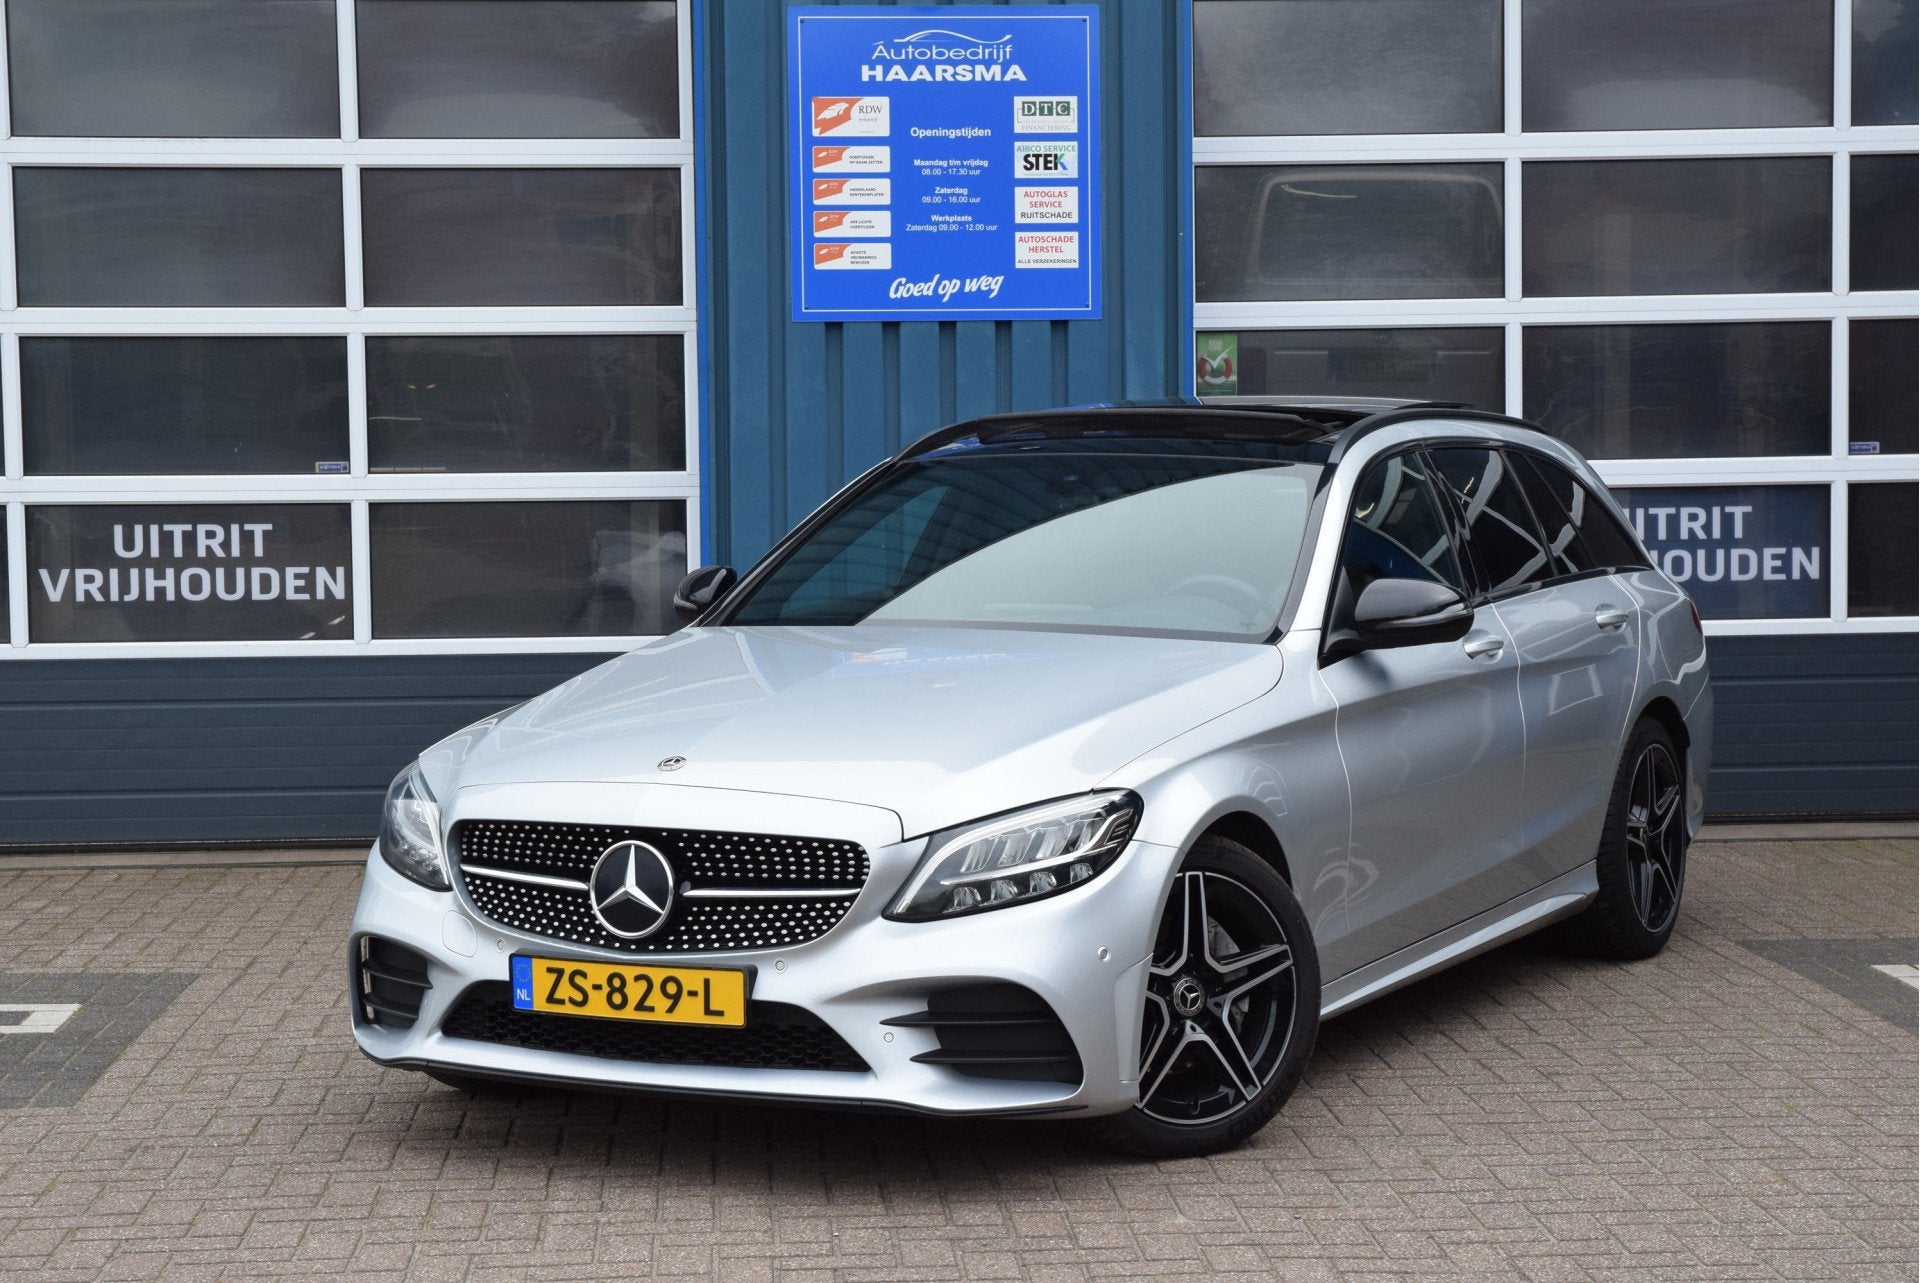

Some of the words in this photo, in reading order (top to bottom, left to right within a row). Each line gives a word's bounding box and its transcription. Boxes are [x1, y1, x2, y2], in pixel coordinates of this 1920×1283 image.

[871, 43, 1012, 62] Autobedrijf
[862, 65, 1027, 81] HAARSMA
[859, 105, 882, 113] RDW
[1023, 103, 1069, 115] DTC
[910, 127, 991, 138] Openingstijden
[914, 159, 948, 167] Maandag
[963, 159, 989, 167] vrijdag
[1023, 154, 1068, 171] STEK
[931, 214, 972, 222] Werkplaats
[906, 224, 937, 232] Zaterdag
[889, 273, 940, 300] Goed
[938, 280, 961, 302] op
[965, 274, 1004, 299] weg
[113, 523, 273, 558] UITRIT
[1650, 546, 1820, 582] OUDEN
[38, 566, 345, 602] VRIJHOUDEN
[517, 988, 531, 1000] NL
[545, 967, 725, 1017] ZS-829-L
